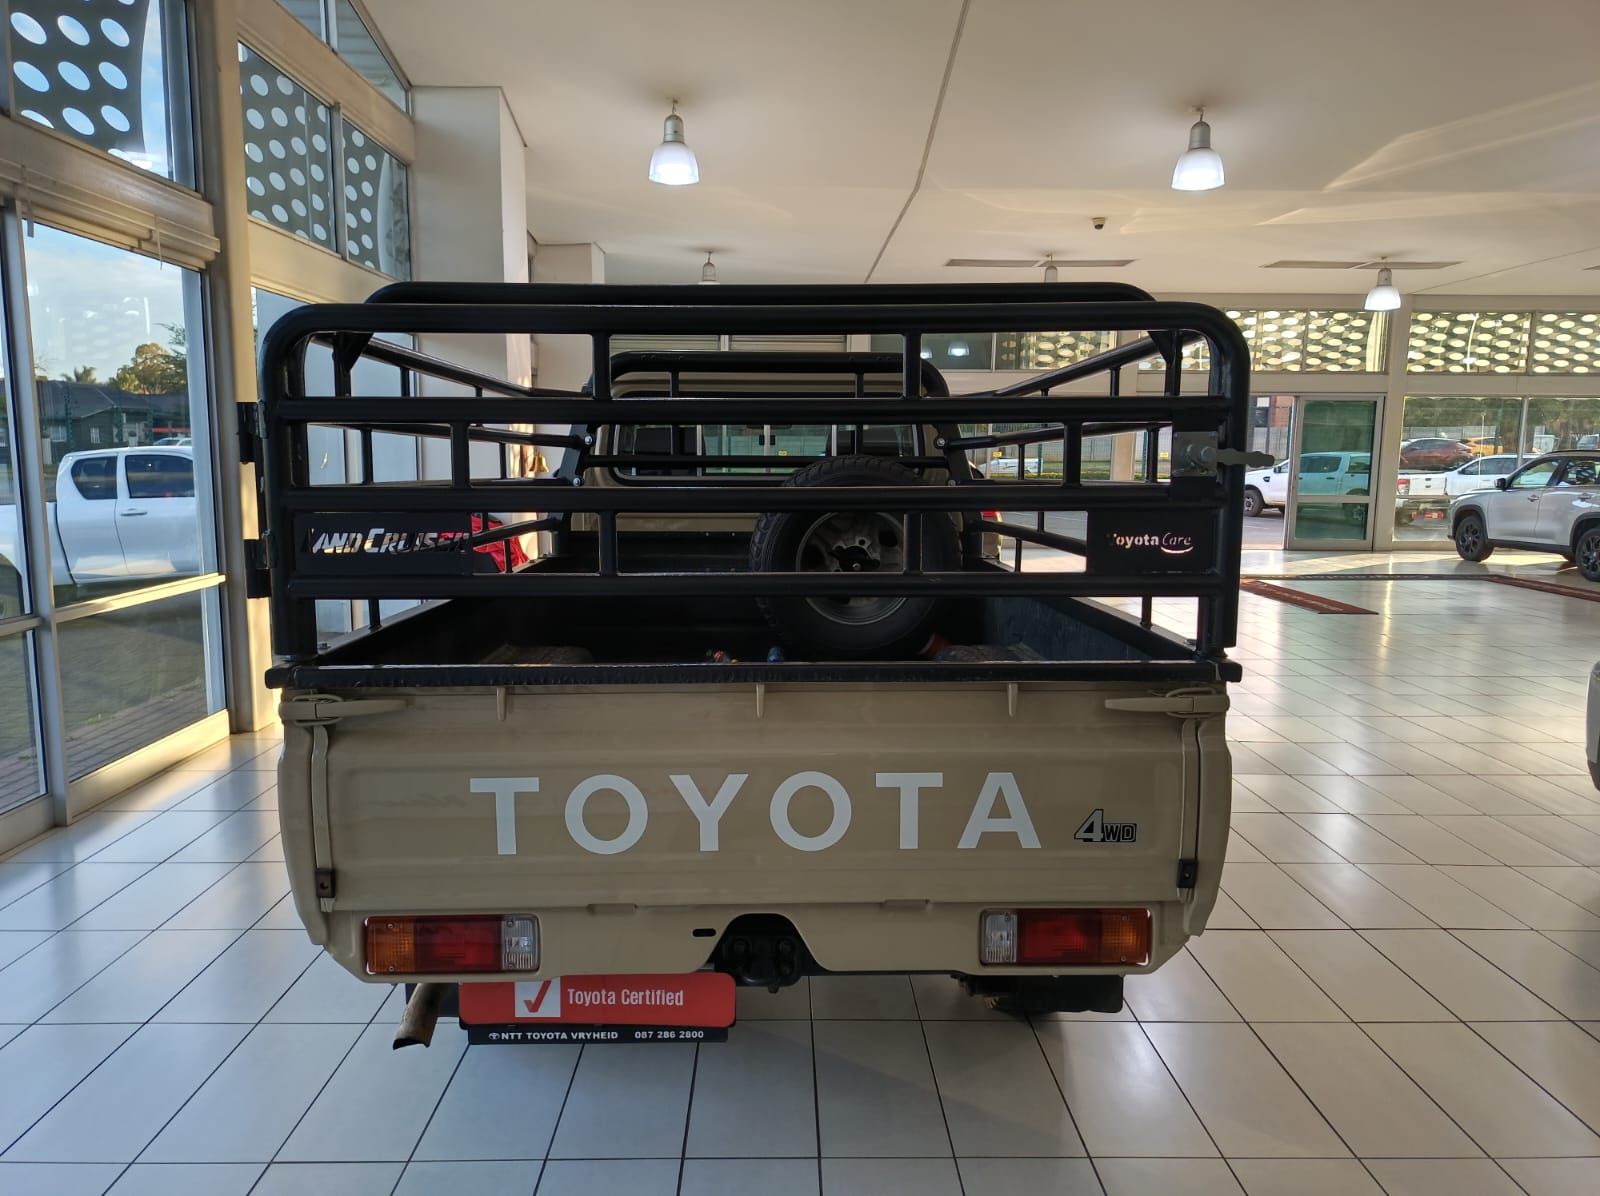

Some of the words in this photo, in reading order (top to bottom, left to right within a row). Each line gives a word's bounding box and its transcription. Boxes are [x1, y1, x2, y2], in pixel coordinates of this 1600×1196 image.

[469, 771, 1042, 855] TOYOTA
[1074, 808, 1138, 843] 4WD
[568, 988, 616, 1007] Toyota
[621, 989, 684, 1006] Certified
[501, 1031, 522, 1040] NTT
[526, 1031, 568, 1040] TOYOTA
[571, 1031, 618, 1040] VRYHEID
[634, 1031, 654, 1039] 087
[657, 1031, 676, 1039] 286
[679, 1030, 704, 1039] 2800
